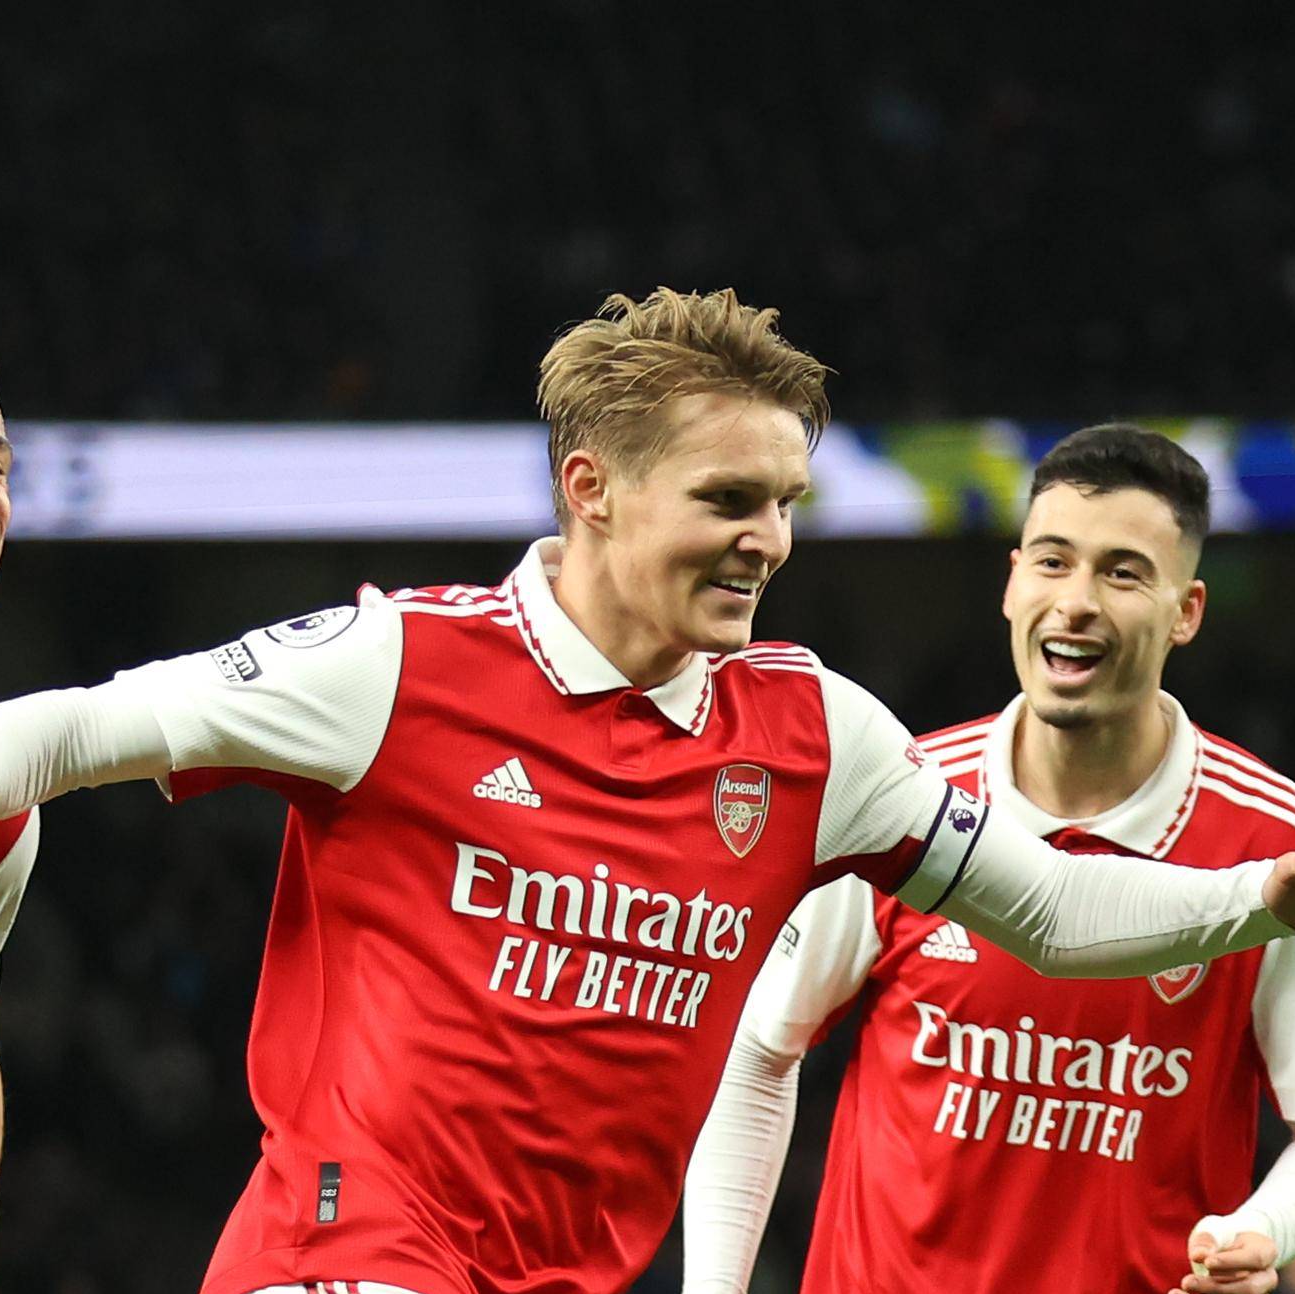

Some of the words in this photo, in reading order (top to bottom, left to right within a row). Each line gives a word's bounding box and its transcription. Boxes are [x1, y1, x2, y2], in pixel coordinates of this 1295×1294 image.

[472, 783, 542, 808] adidas
[721, 778, 764, 796] Arsenal
[451, 842, 753, 962] Emirates
[488, 935, 572, 1002] FLY
[574, 950, 711, 1029] BETTER
[919, 941, 979, 964] adidas
[910, 1000, 1193, 1098] Emirates
[933, 1081, 1002, 1142] FLY
[1006, 1094, 1144, 1163] BETTER
